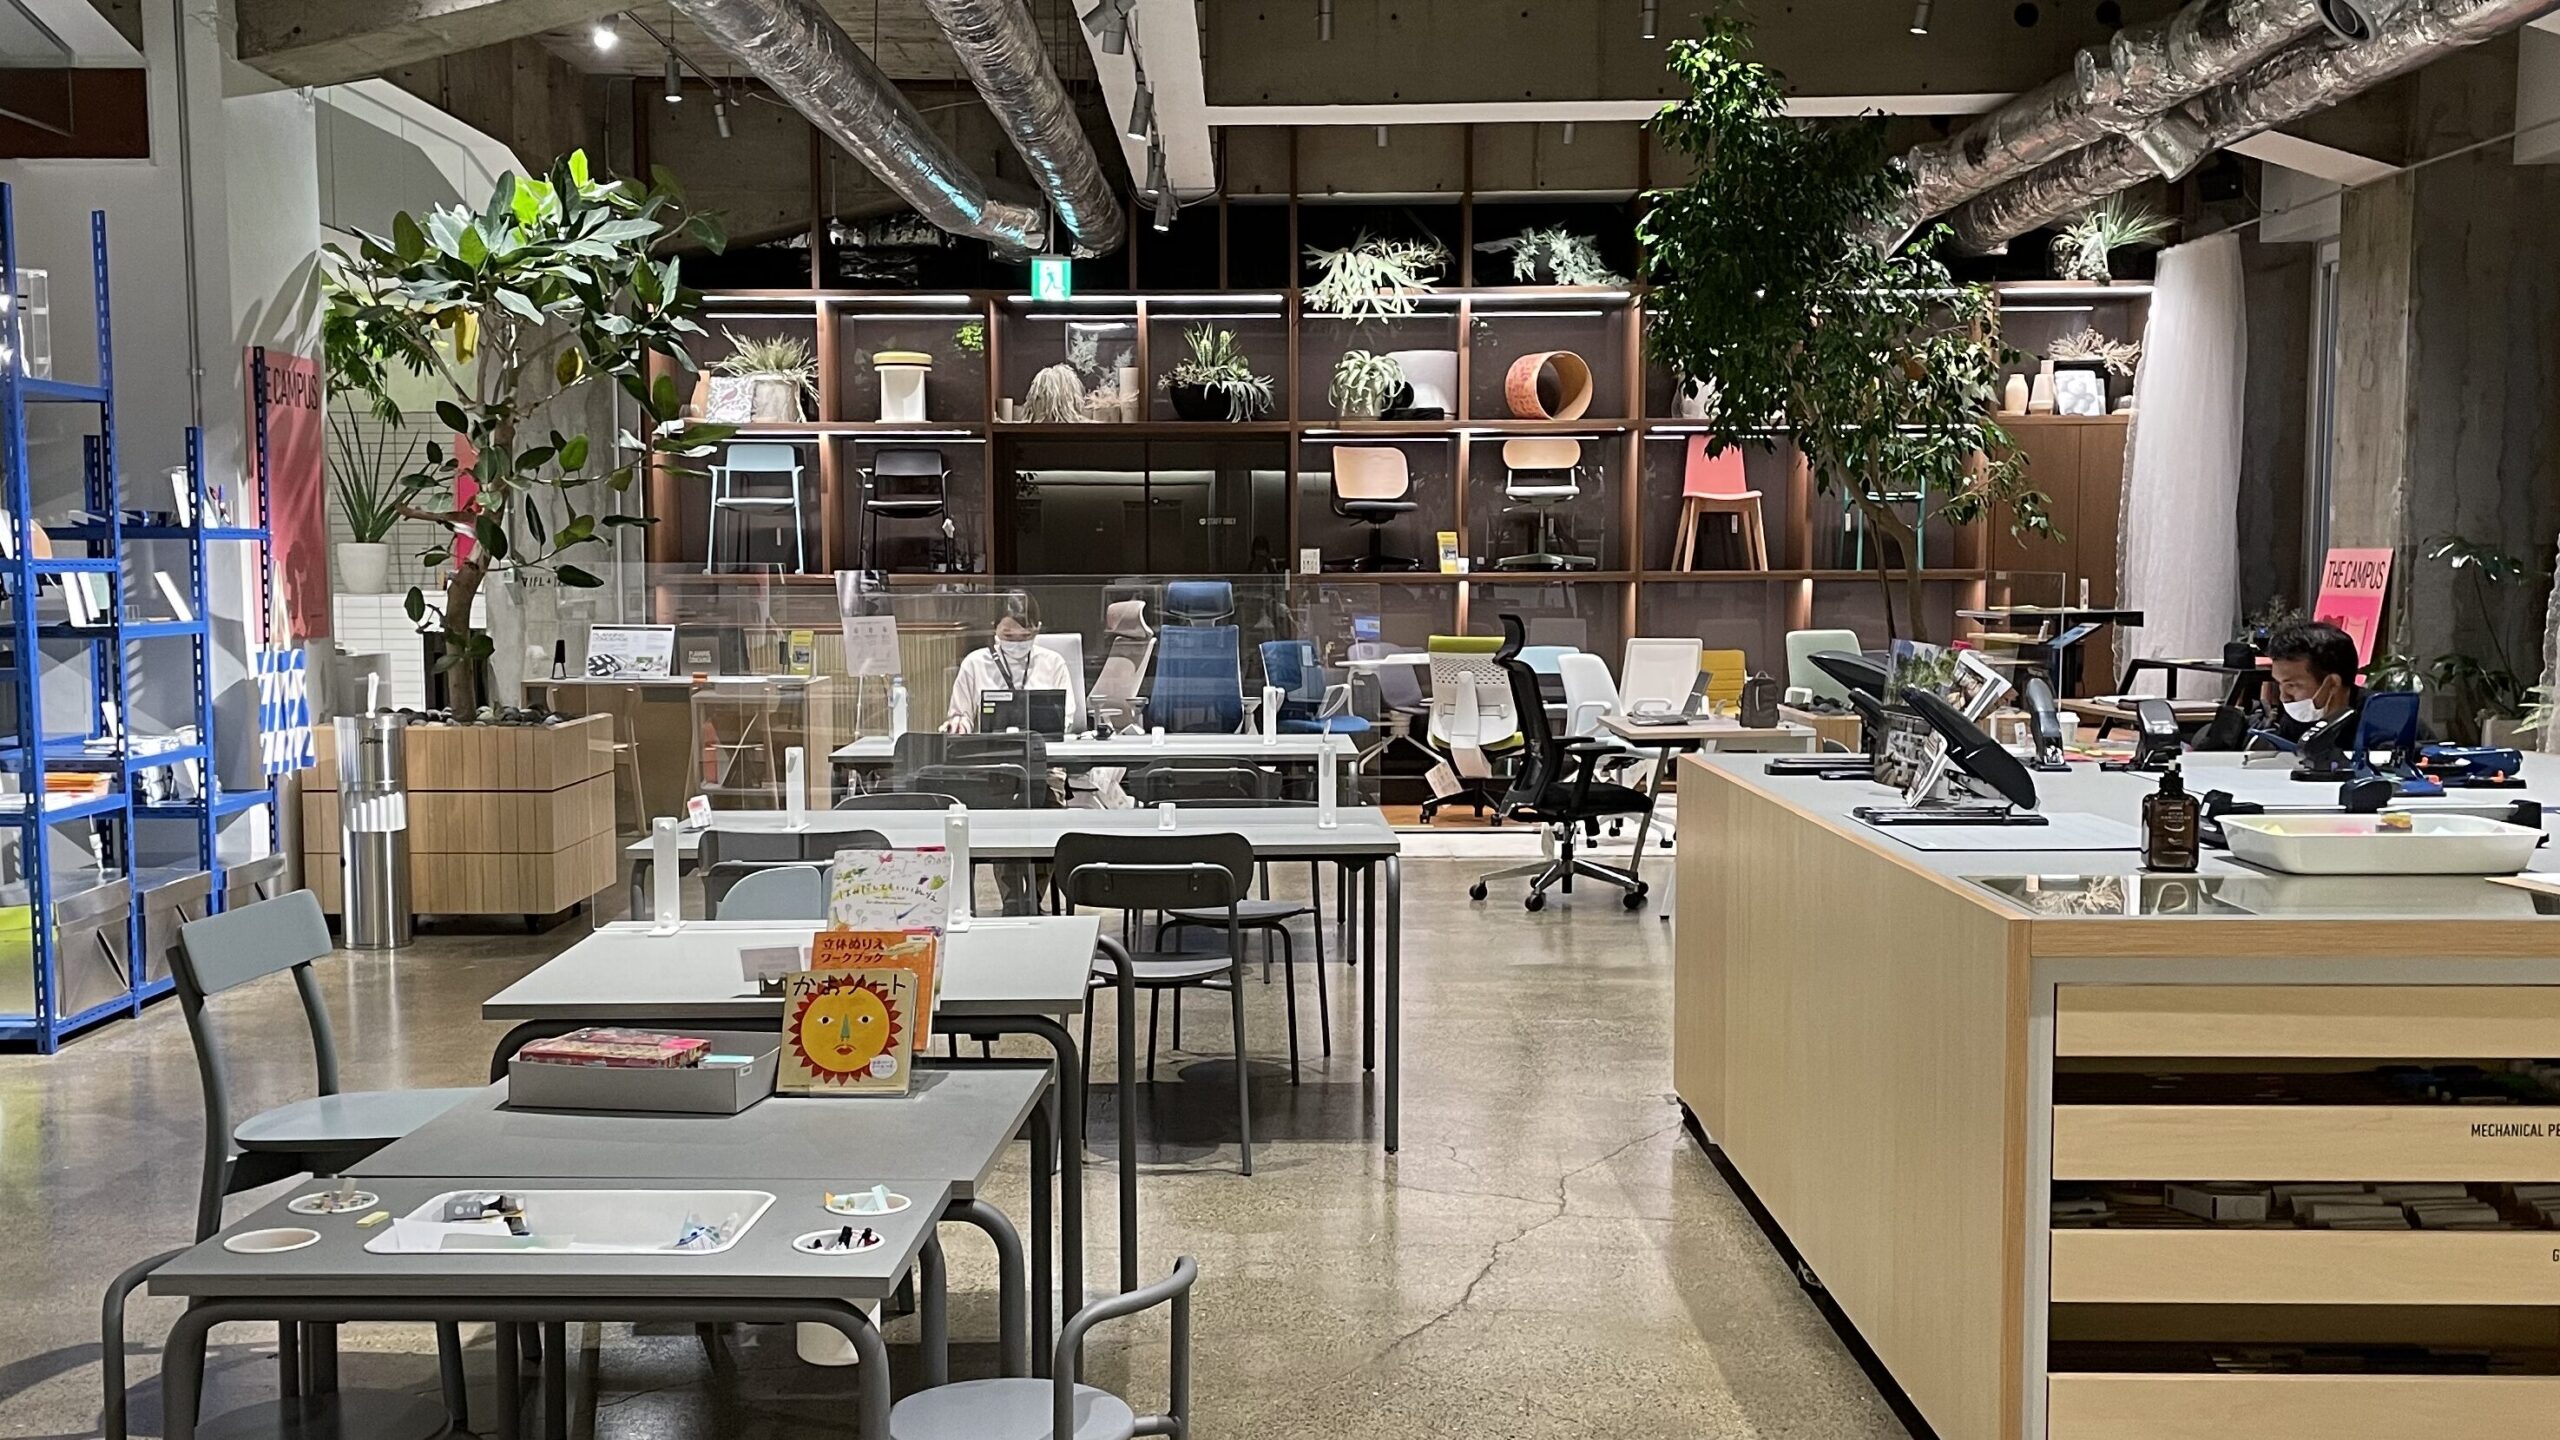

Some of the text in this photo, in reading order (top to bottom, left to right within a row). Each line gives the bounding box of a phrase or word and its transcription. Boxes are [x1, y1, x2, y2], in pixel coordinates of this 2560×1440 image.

[273, 367, 318, 410] CAMPUS
[2326, 561, 2386, 589] THE CAMPUS
[824, 938, 885, 950] 立体ぬりえ
[821, 952, 884, 963] ワークブック
[793, 973, 906, 996] かおノート
[2471, 1123, 2544, 1137] MECHANICAL
